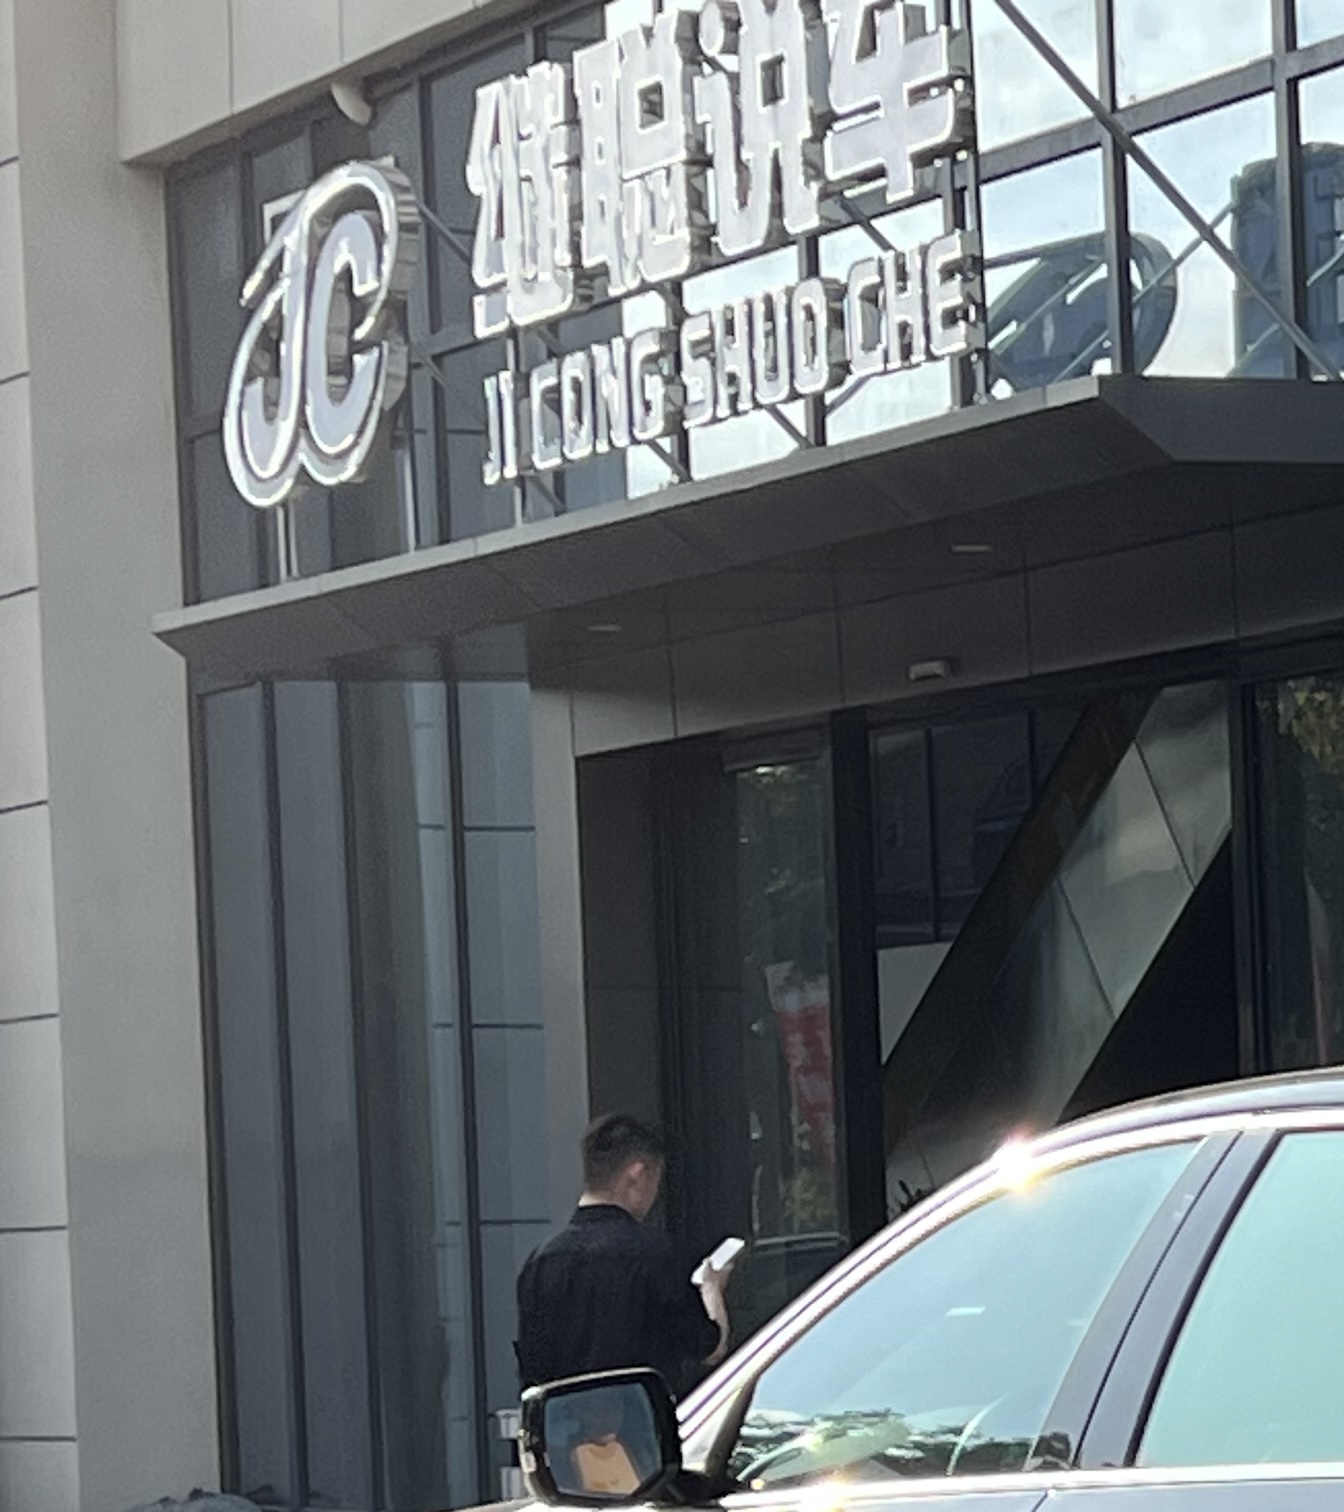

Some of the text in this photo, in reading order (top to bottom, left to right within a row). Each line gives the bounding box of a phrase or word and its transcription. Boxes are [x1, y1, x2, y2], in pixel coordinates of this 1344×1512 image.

[481, 232, 974, 486] JI CONG SHUO CHE
